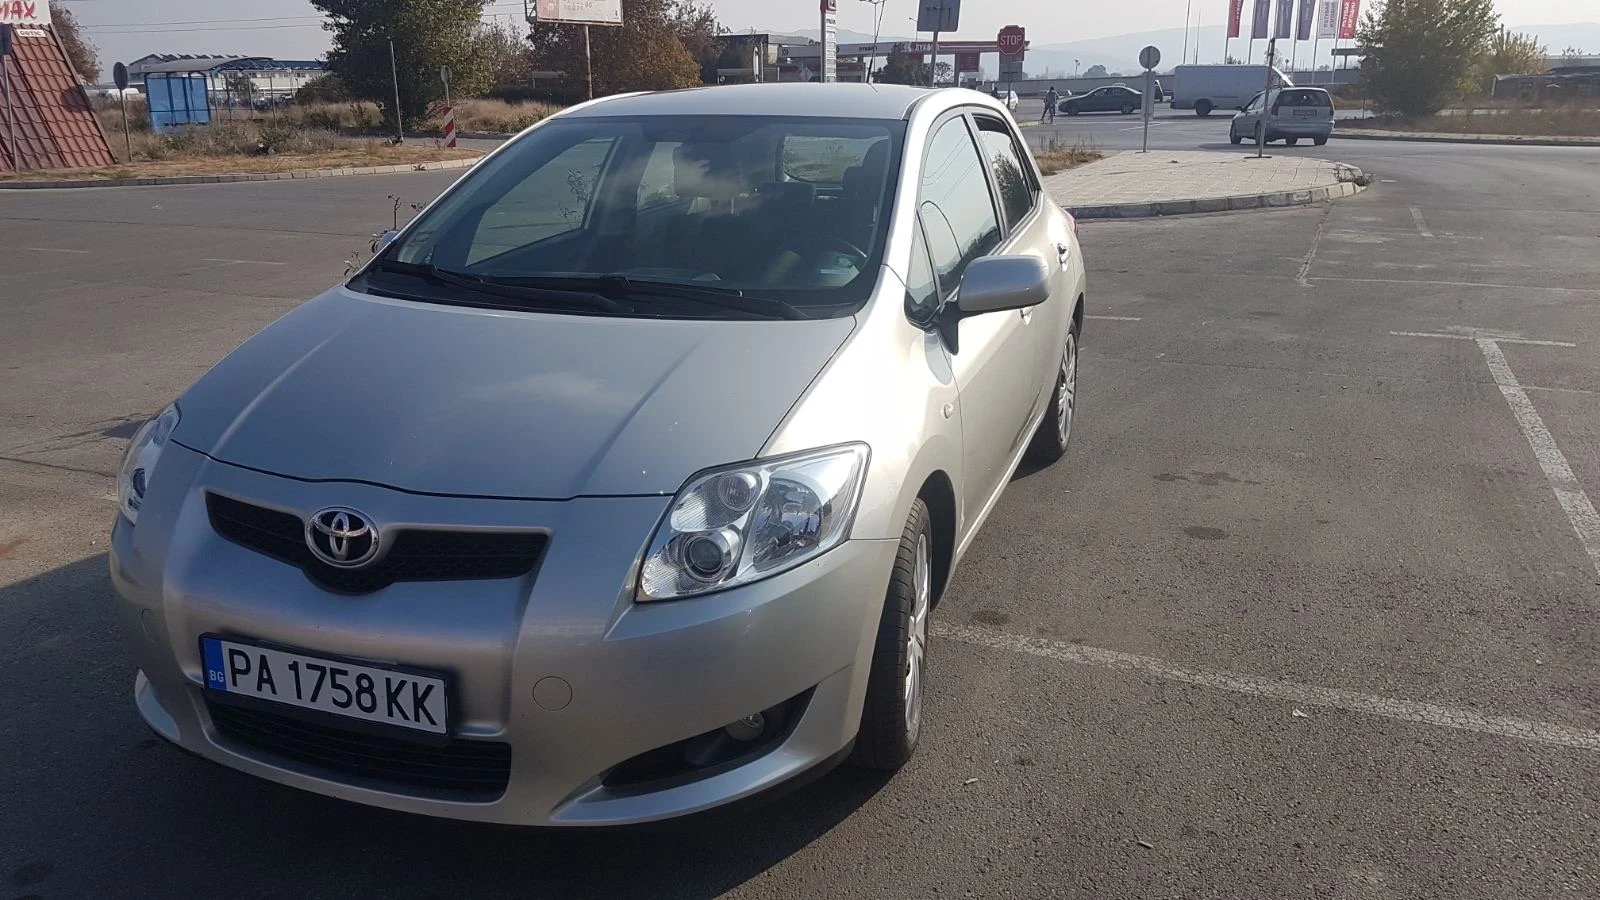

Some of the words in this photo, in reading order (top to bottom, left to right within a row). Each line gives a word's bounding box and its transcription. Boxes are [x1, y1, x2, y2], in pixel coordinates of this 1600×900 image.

[1000, 35, 1022, 46] STOP
[209, 669, 225, 684] BG
[228, 647, 277, 695] PA
[288, 660, 377, 714] 1758
[385, 676, 438, 726] KK
